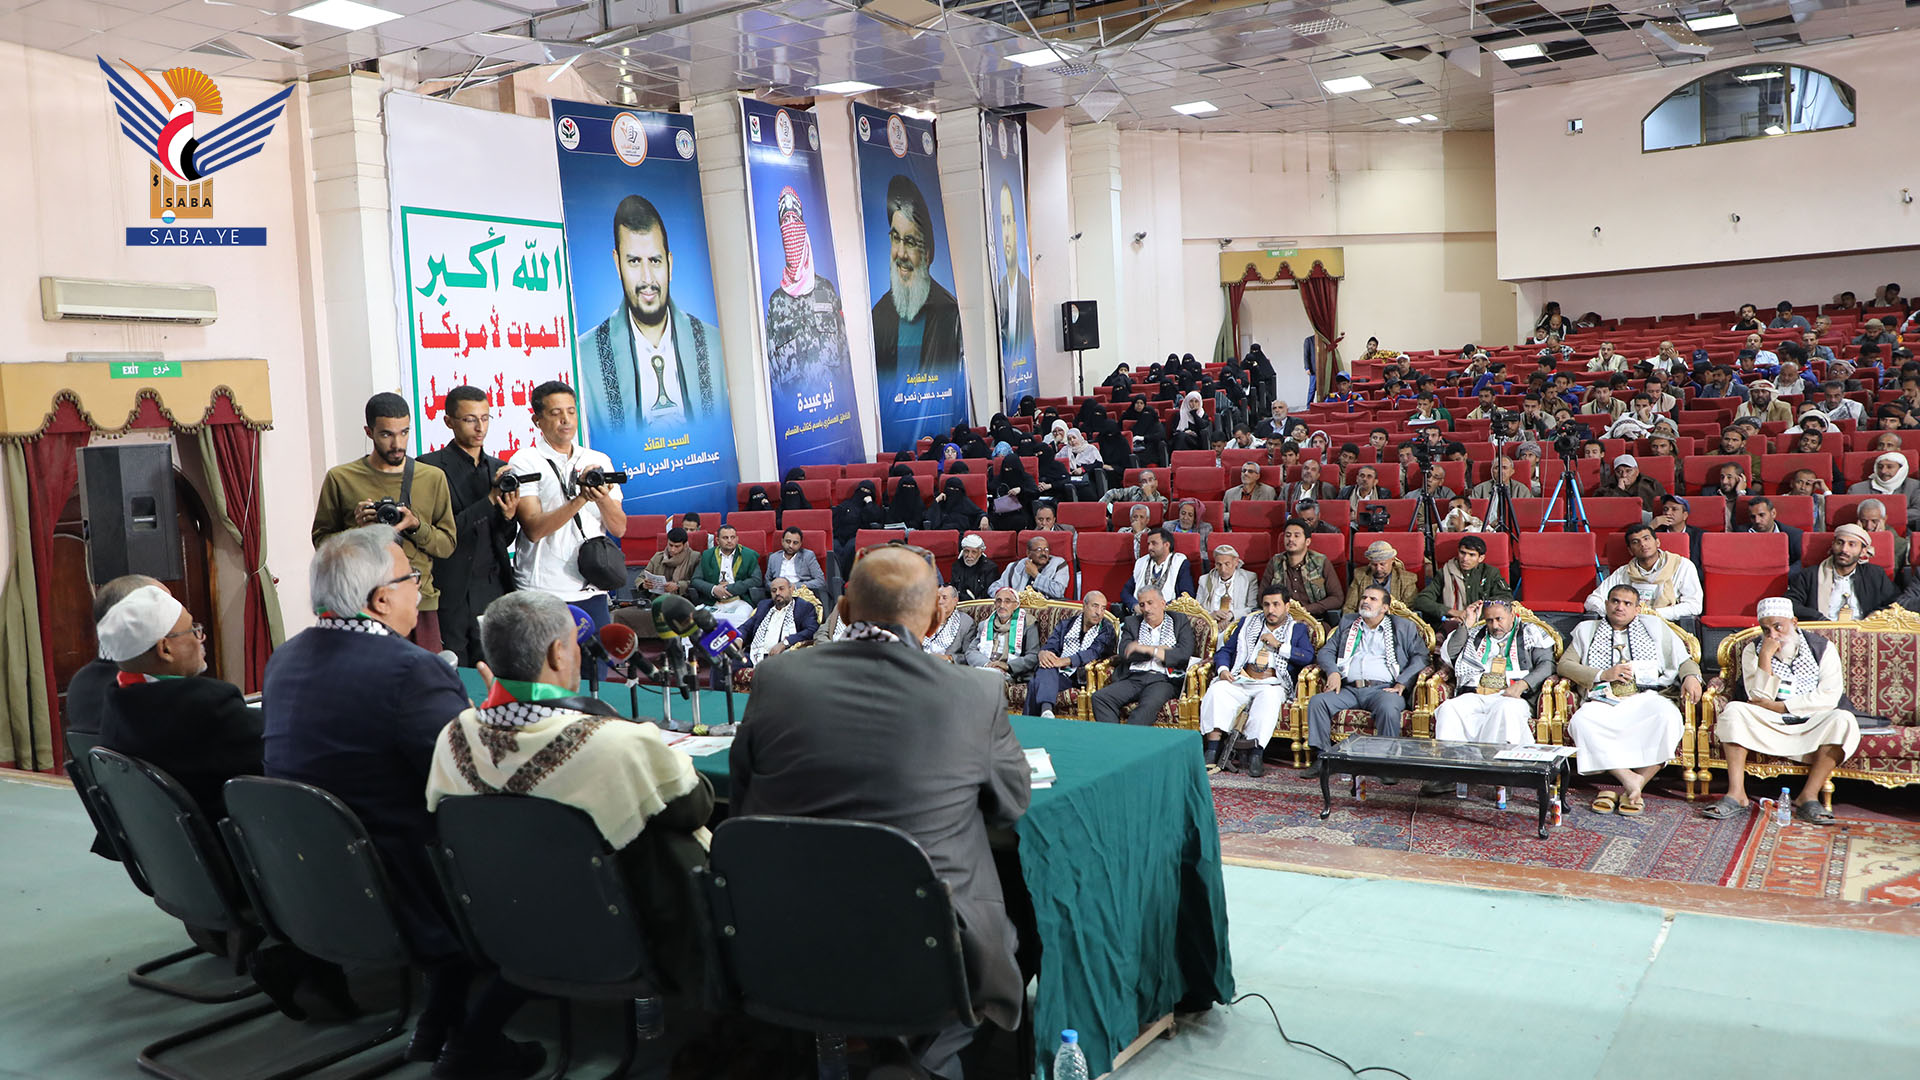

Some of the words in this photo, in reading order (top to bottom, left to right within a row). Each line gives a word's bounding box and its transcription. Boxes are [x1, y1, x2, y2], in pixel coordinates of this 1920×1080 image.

[415, 226, 506, 307] أكبر
[512, 238, 562, 291] الله
[419, 304, 501, 358] لأمريكا
[507, 315, 566, 357] الموت
[122, 365, 139, 375] EXIT
[152, 364, 170, 376] خروج
[797, 392, 822, 413] عبيدة
[823, 381, 835, 410] أبو
[917, 392, 935, 403] حسن
[936, 388, 952, 400] السيد
[643, 436, 666, 451] القائد
[667, 433, 690, 450] السيد
[622, 461, 647, 479] الحوث
[647, 457, 670, 476] الدين
[670, 459, 684, 472] بدر
[1346, 616, 1362, 653] PALESTIN
